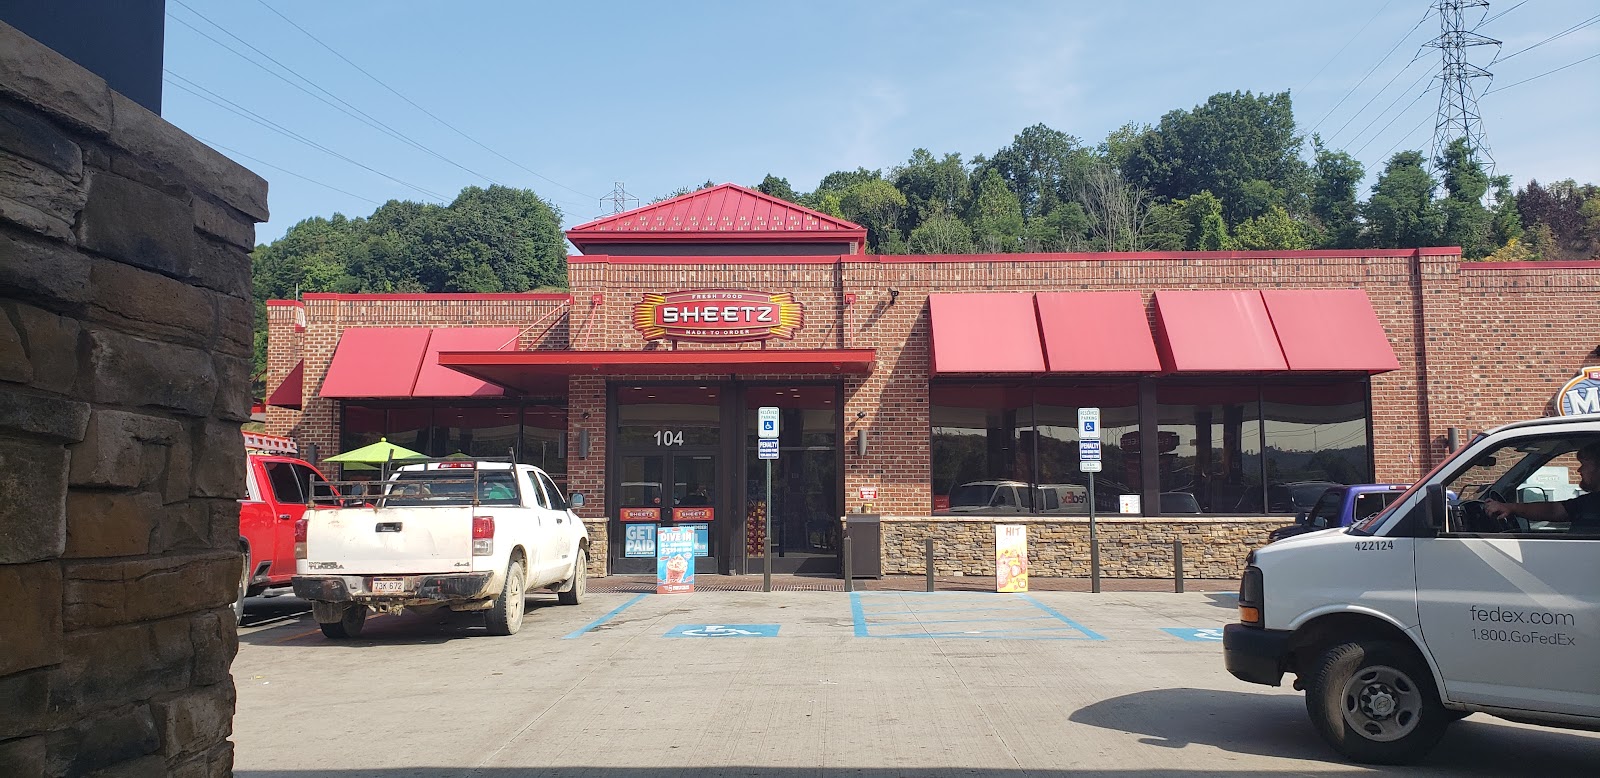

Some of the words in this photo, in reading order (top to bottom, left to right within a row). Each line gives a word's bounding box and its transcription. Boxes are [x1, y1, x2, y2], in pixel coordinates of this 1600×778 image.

[662, 305, 773, 323] SHEETZ
[653, 430, 684, 447] 104
[627, 526, 654, 540] GET
[661, 532, 681, 541] DIVE
[683, 532, 692, 541] IN
[1005, 527, 1021, 536] HIT
[625, 540, 655, 551] PAID
[1354, 540, 1394, 551] 422124
[374, 582, 387, 590] 73K
[389, 582, 403, 590] 672
[1469, 605, 1575, 626] fedex.com
[1471, 628, 1576, 646] 1.800.GoFedEx
